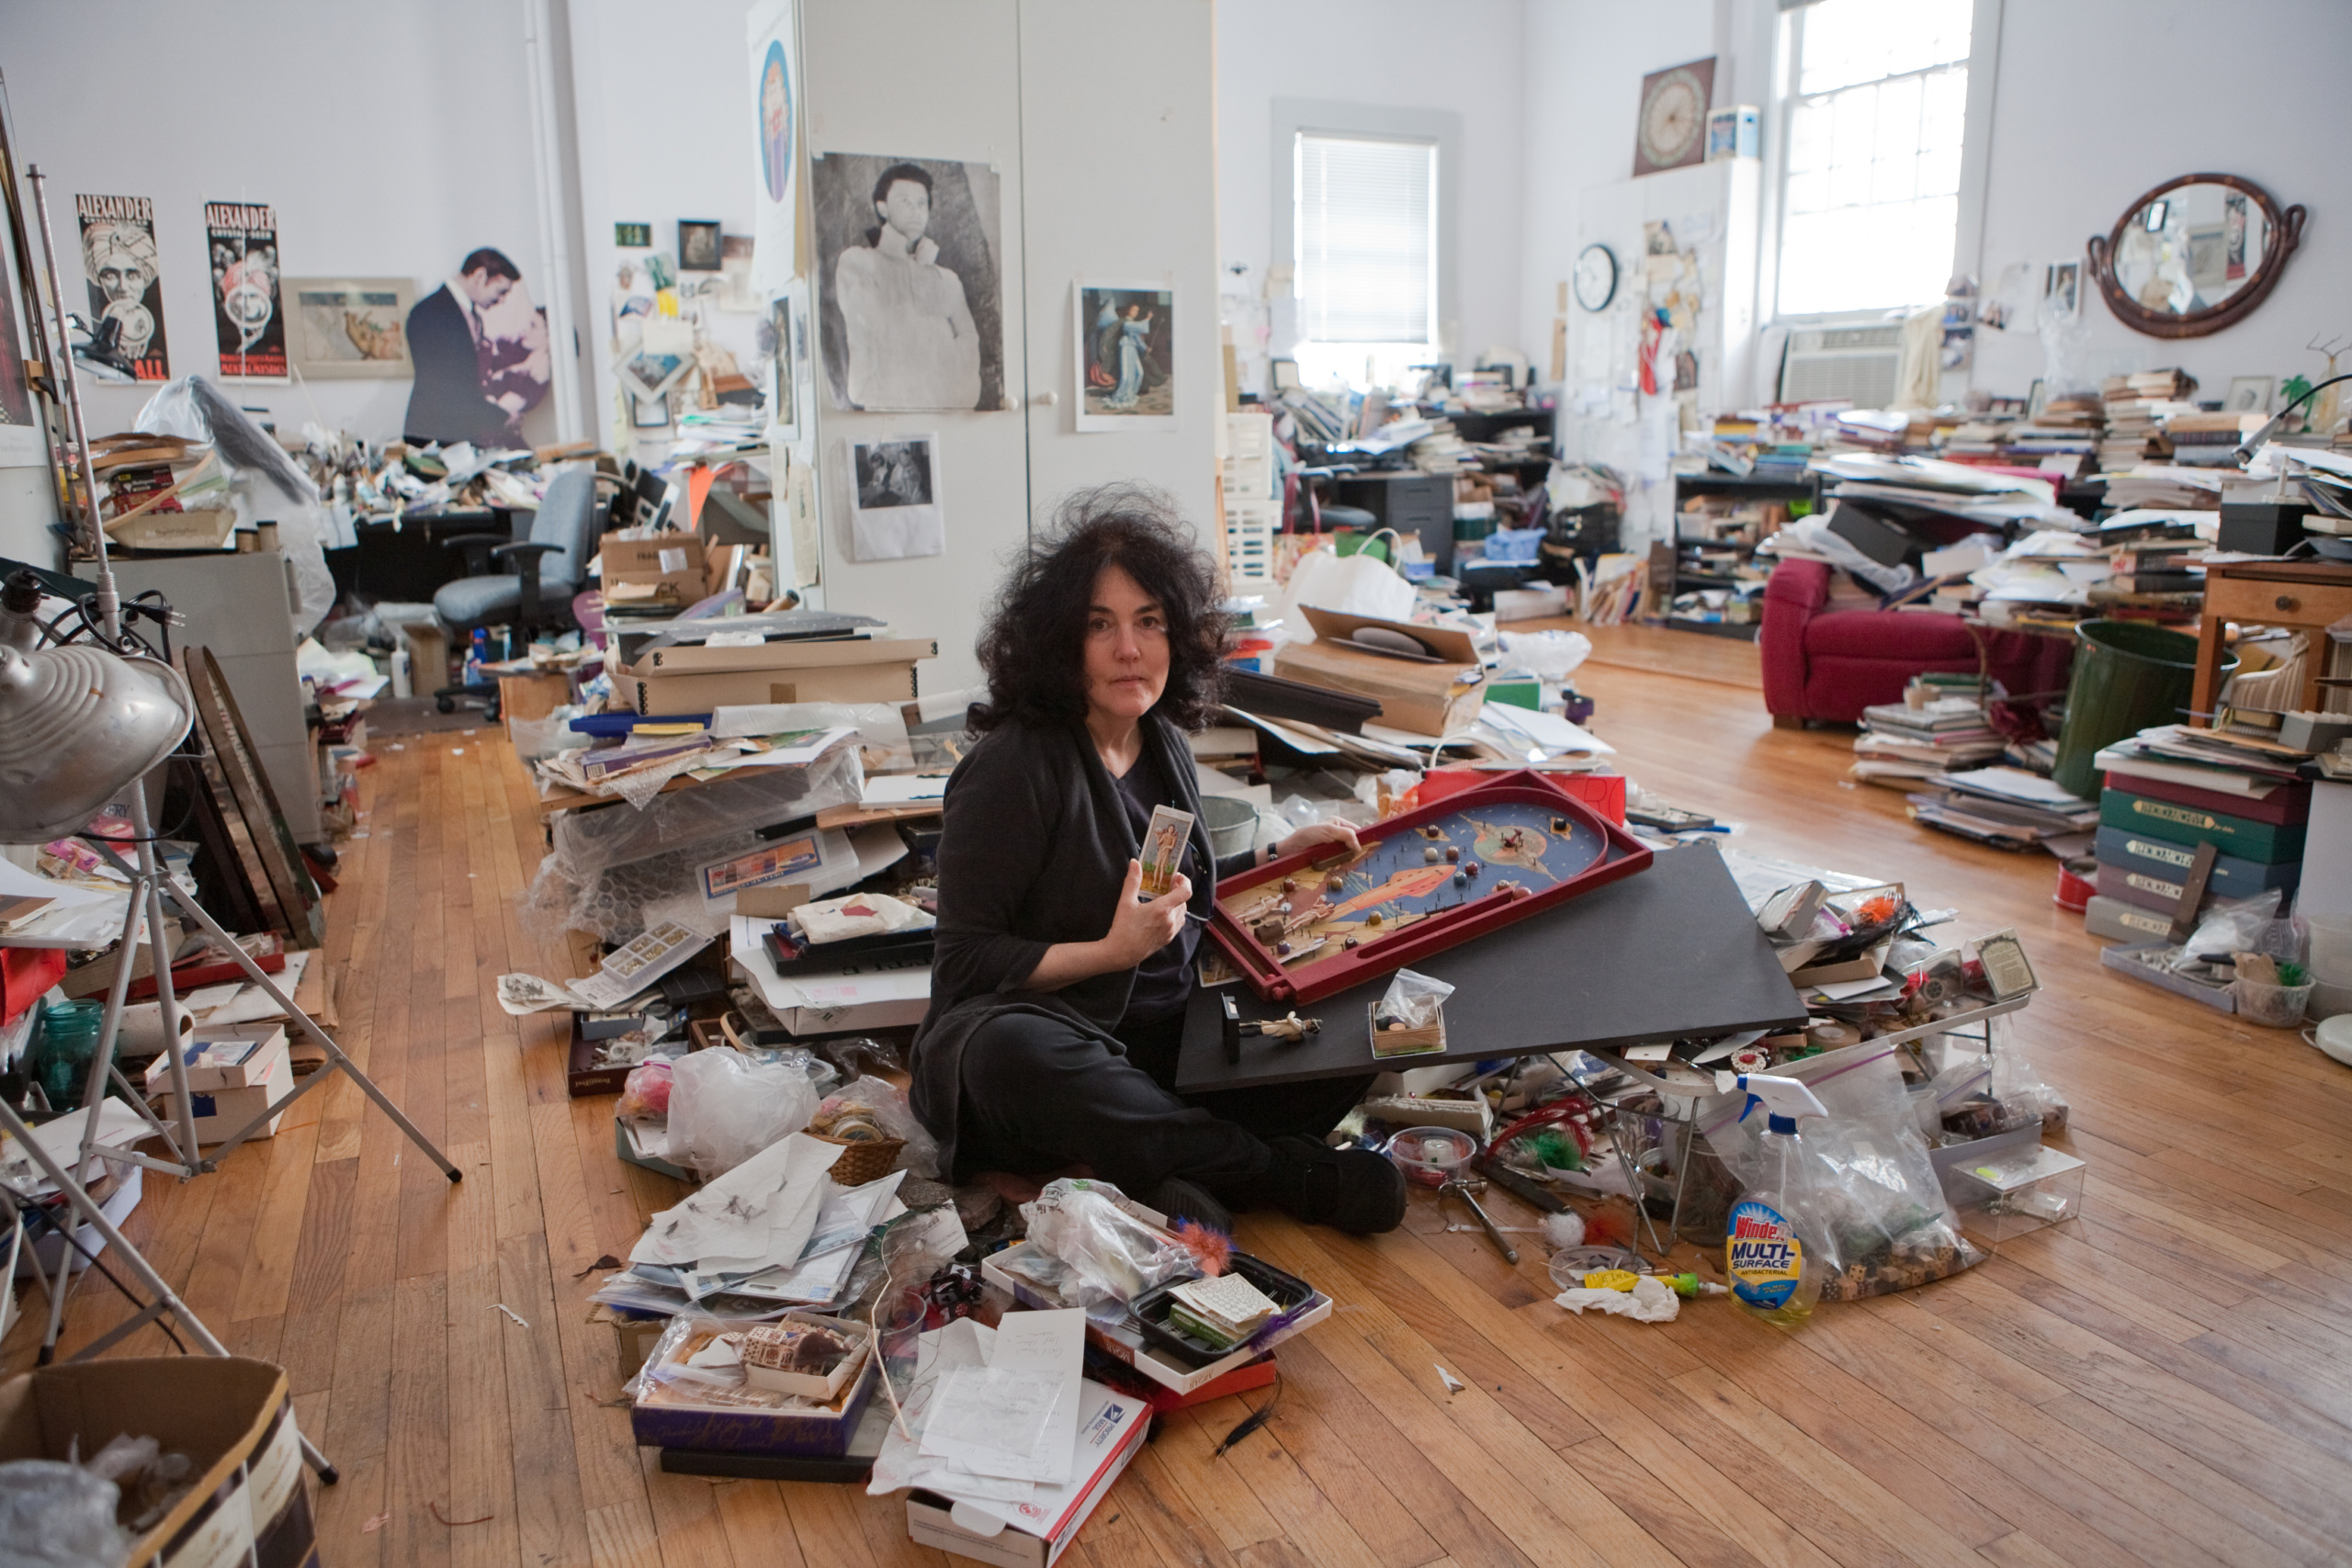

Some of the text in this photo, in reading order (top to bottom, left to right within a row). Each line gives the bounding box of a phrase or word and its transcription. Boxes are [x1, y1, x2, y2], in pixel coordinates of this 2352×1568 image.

[78, 195, 153, 220] ALEXANDER
[207, 204, 276, 229] ALEXANDER
[135, 359, 166, 379] ALL
[1731, 1242, 1795, 1260] MULTI-
[1732, 1259, 1790, 1269] SURFACE
[1091, 1417, 1106, 1430] MAIL
[1094, 1423, 1115, 1448] PRIORITY
